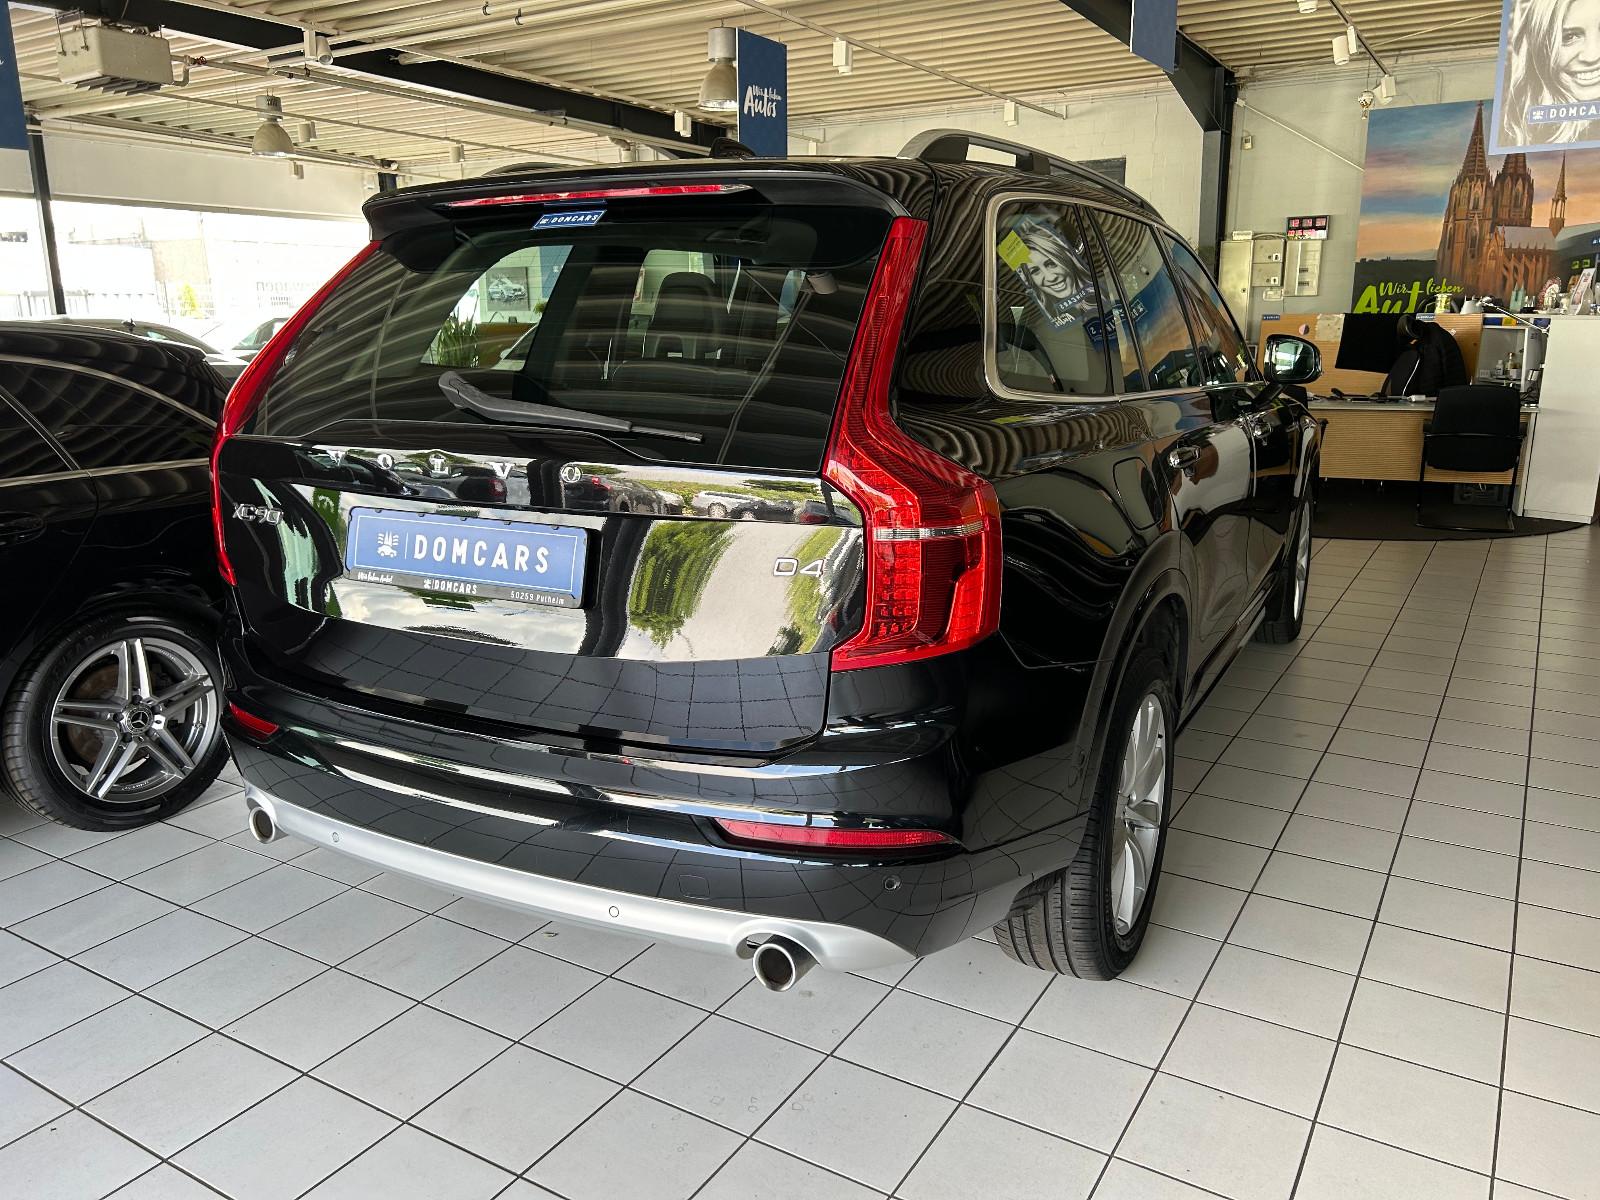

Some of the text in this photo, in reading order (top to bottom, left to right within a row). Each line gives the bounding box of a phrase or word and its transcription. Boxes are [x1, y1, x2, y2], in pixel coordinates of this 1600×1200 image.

[743, 85, 777, 118] Autos
[1550, 104, 1600, 119] DOMCA
[550, 214, 599, 224] DOMCARS
[1352, 281, 1421, 313] Aut
[1379, 277, 1464, 297] Wir lieben
[326, 449, 583, 483] VOLVO
[232, 502, 284, 526] XC90
[413, 533, 550, 574] DOMCARS
[773, 557, 824, 577] D4
[434, 578, 478, 595] DOMCARS
[510, 590, 535, 601] 50259
